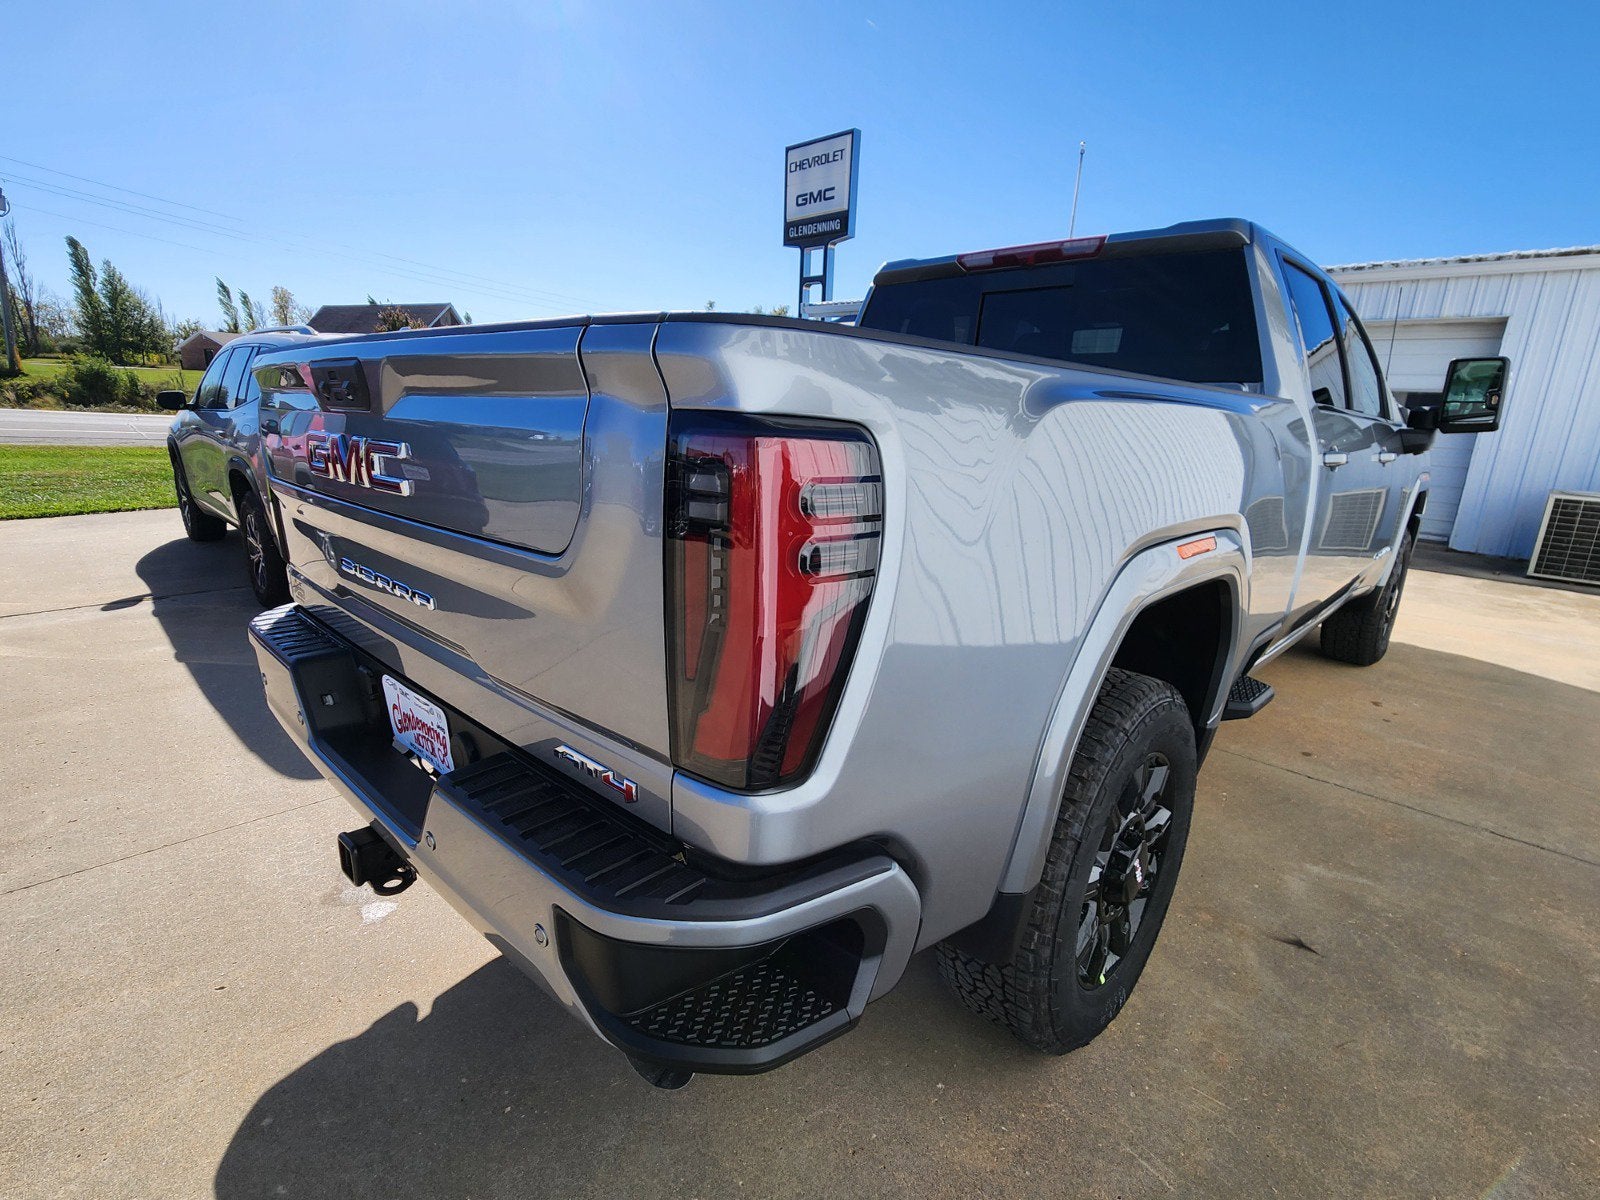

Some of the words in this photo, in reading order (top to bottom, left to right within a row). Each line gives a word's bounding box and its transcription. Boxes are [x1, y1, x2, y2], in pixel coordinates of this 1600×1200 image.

[789, 148, 845, 173] CHEVROLET
[795, 186, 835, 207] GMC
[788, 219, 841, 237] GLENDENNING
[306, 430, 413, 496] GMC
[340, 556, 437, 610] SIERRA
[392, 693, 448, 758] Glendenning
[554, 744, 639, 803] AT4
